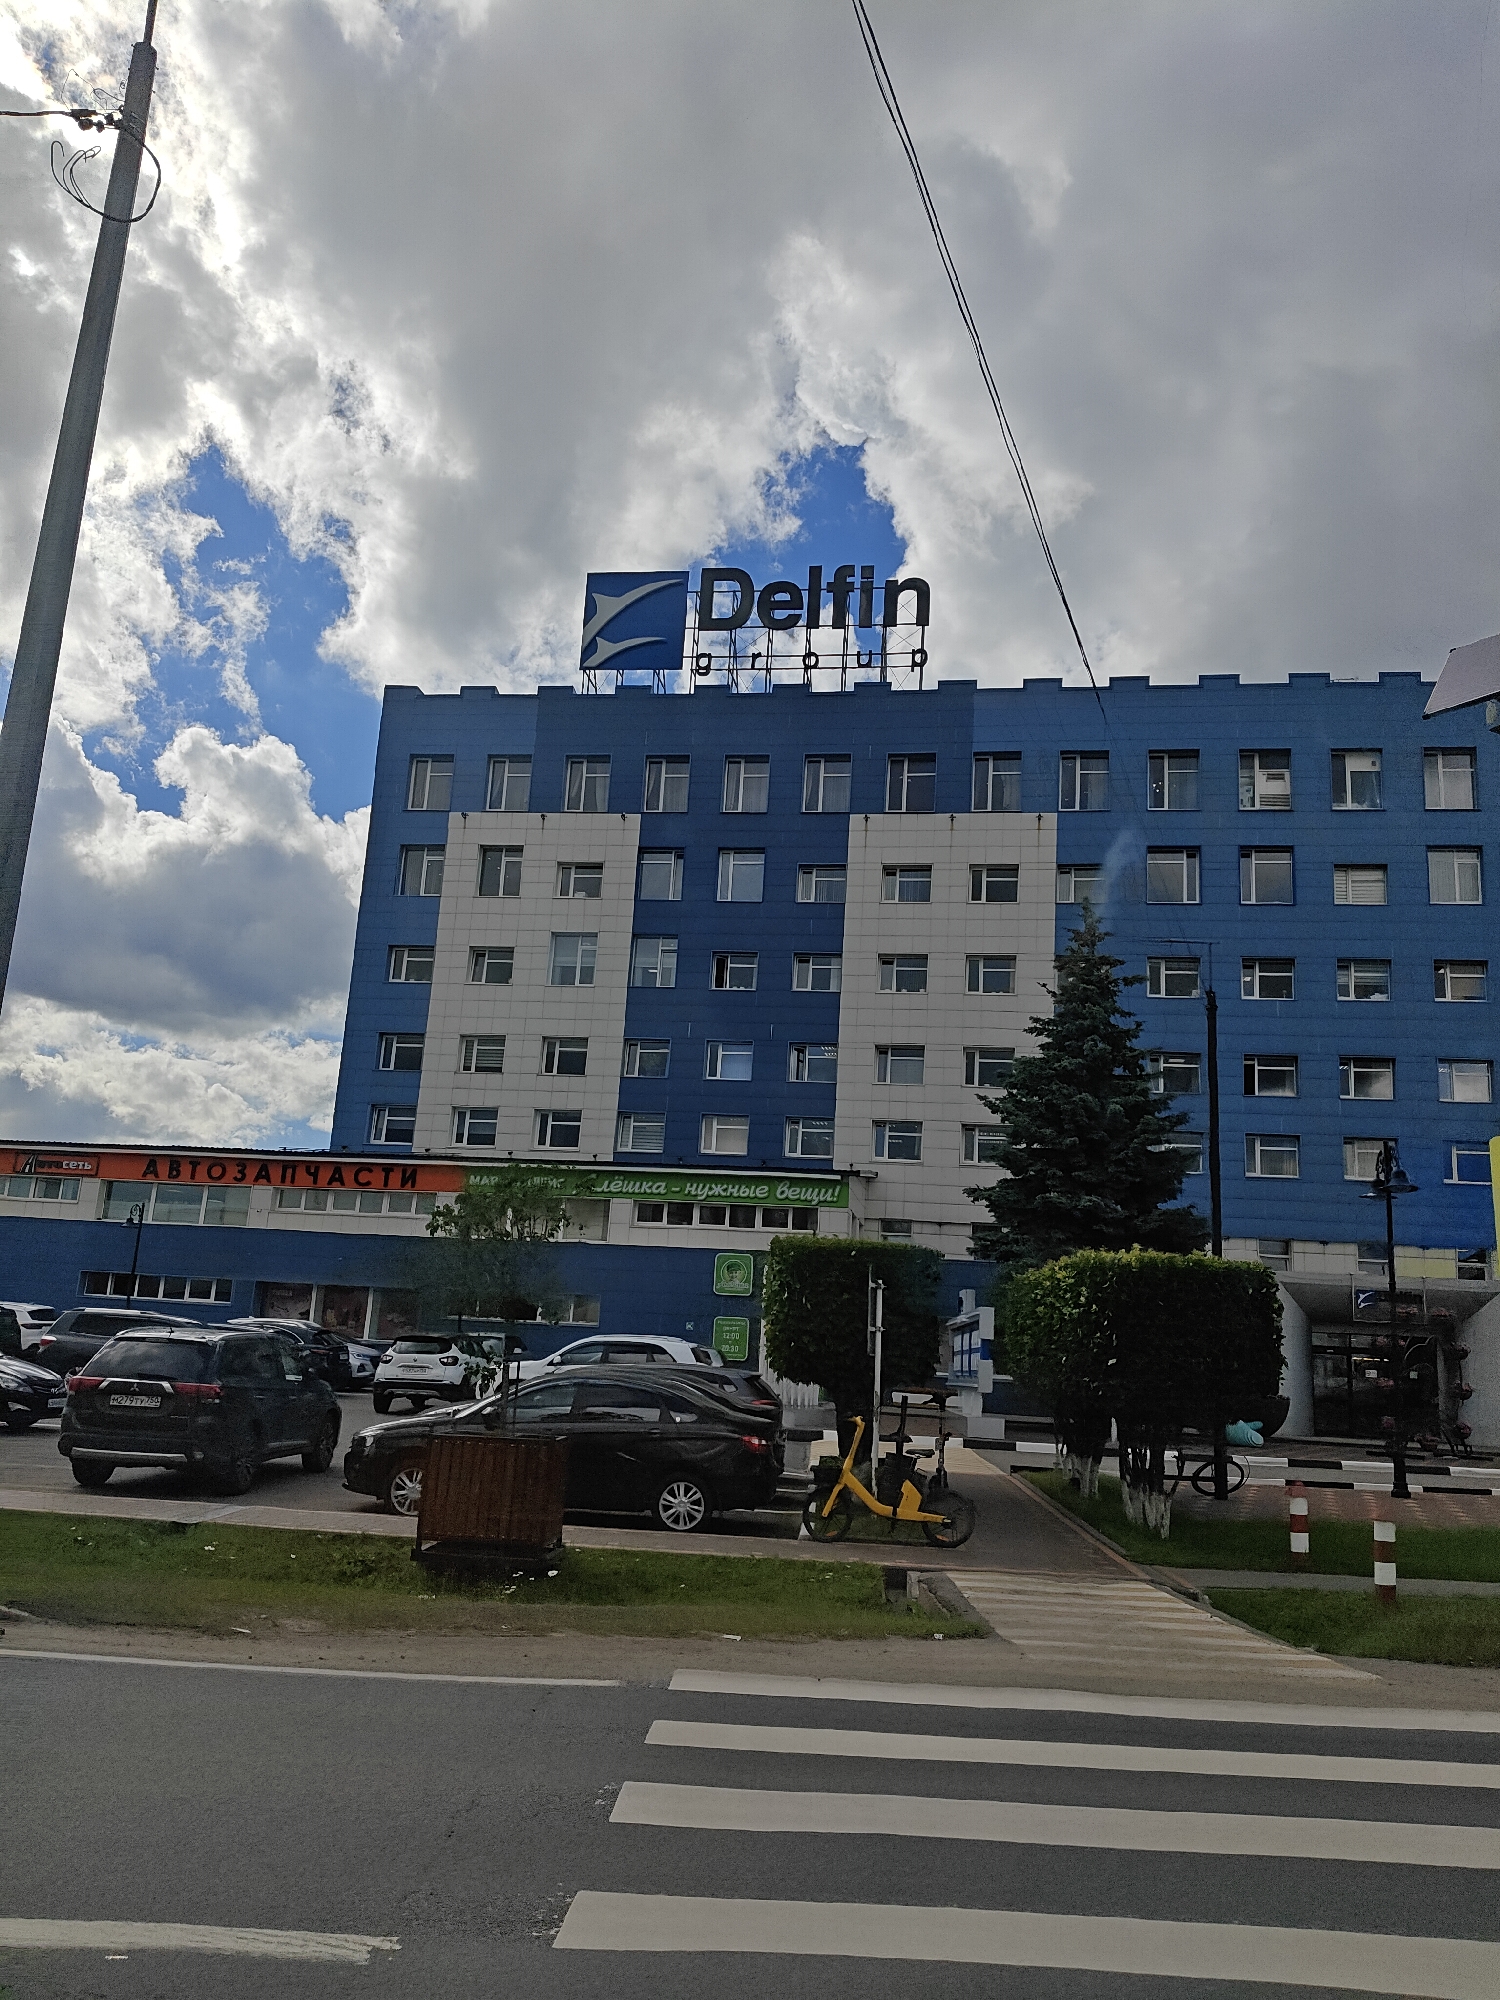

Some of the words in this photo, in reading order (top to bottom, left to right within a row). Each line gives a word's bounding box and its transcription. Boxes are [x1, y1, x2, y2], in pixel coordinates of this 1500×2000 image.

[697, 565, 931, 631] Delfin
[696, 647, 928, 676] group
[141, 1158, 418, 1188] АВТОЗАПЧАСТИ
[685, 1181, 769, 1200] нужные
[775, 1180, 842, 1205] вещи!
